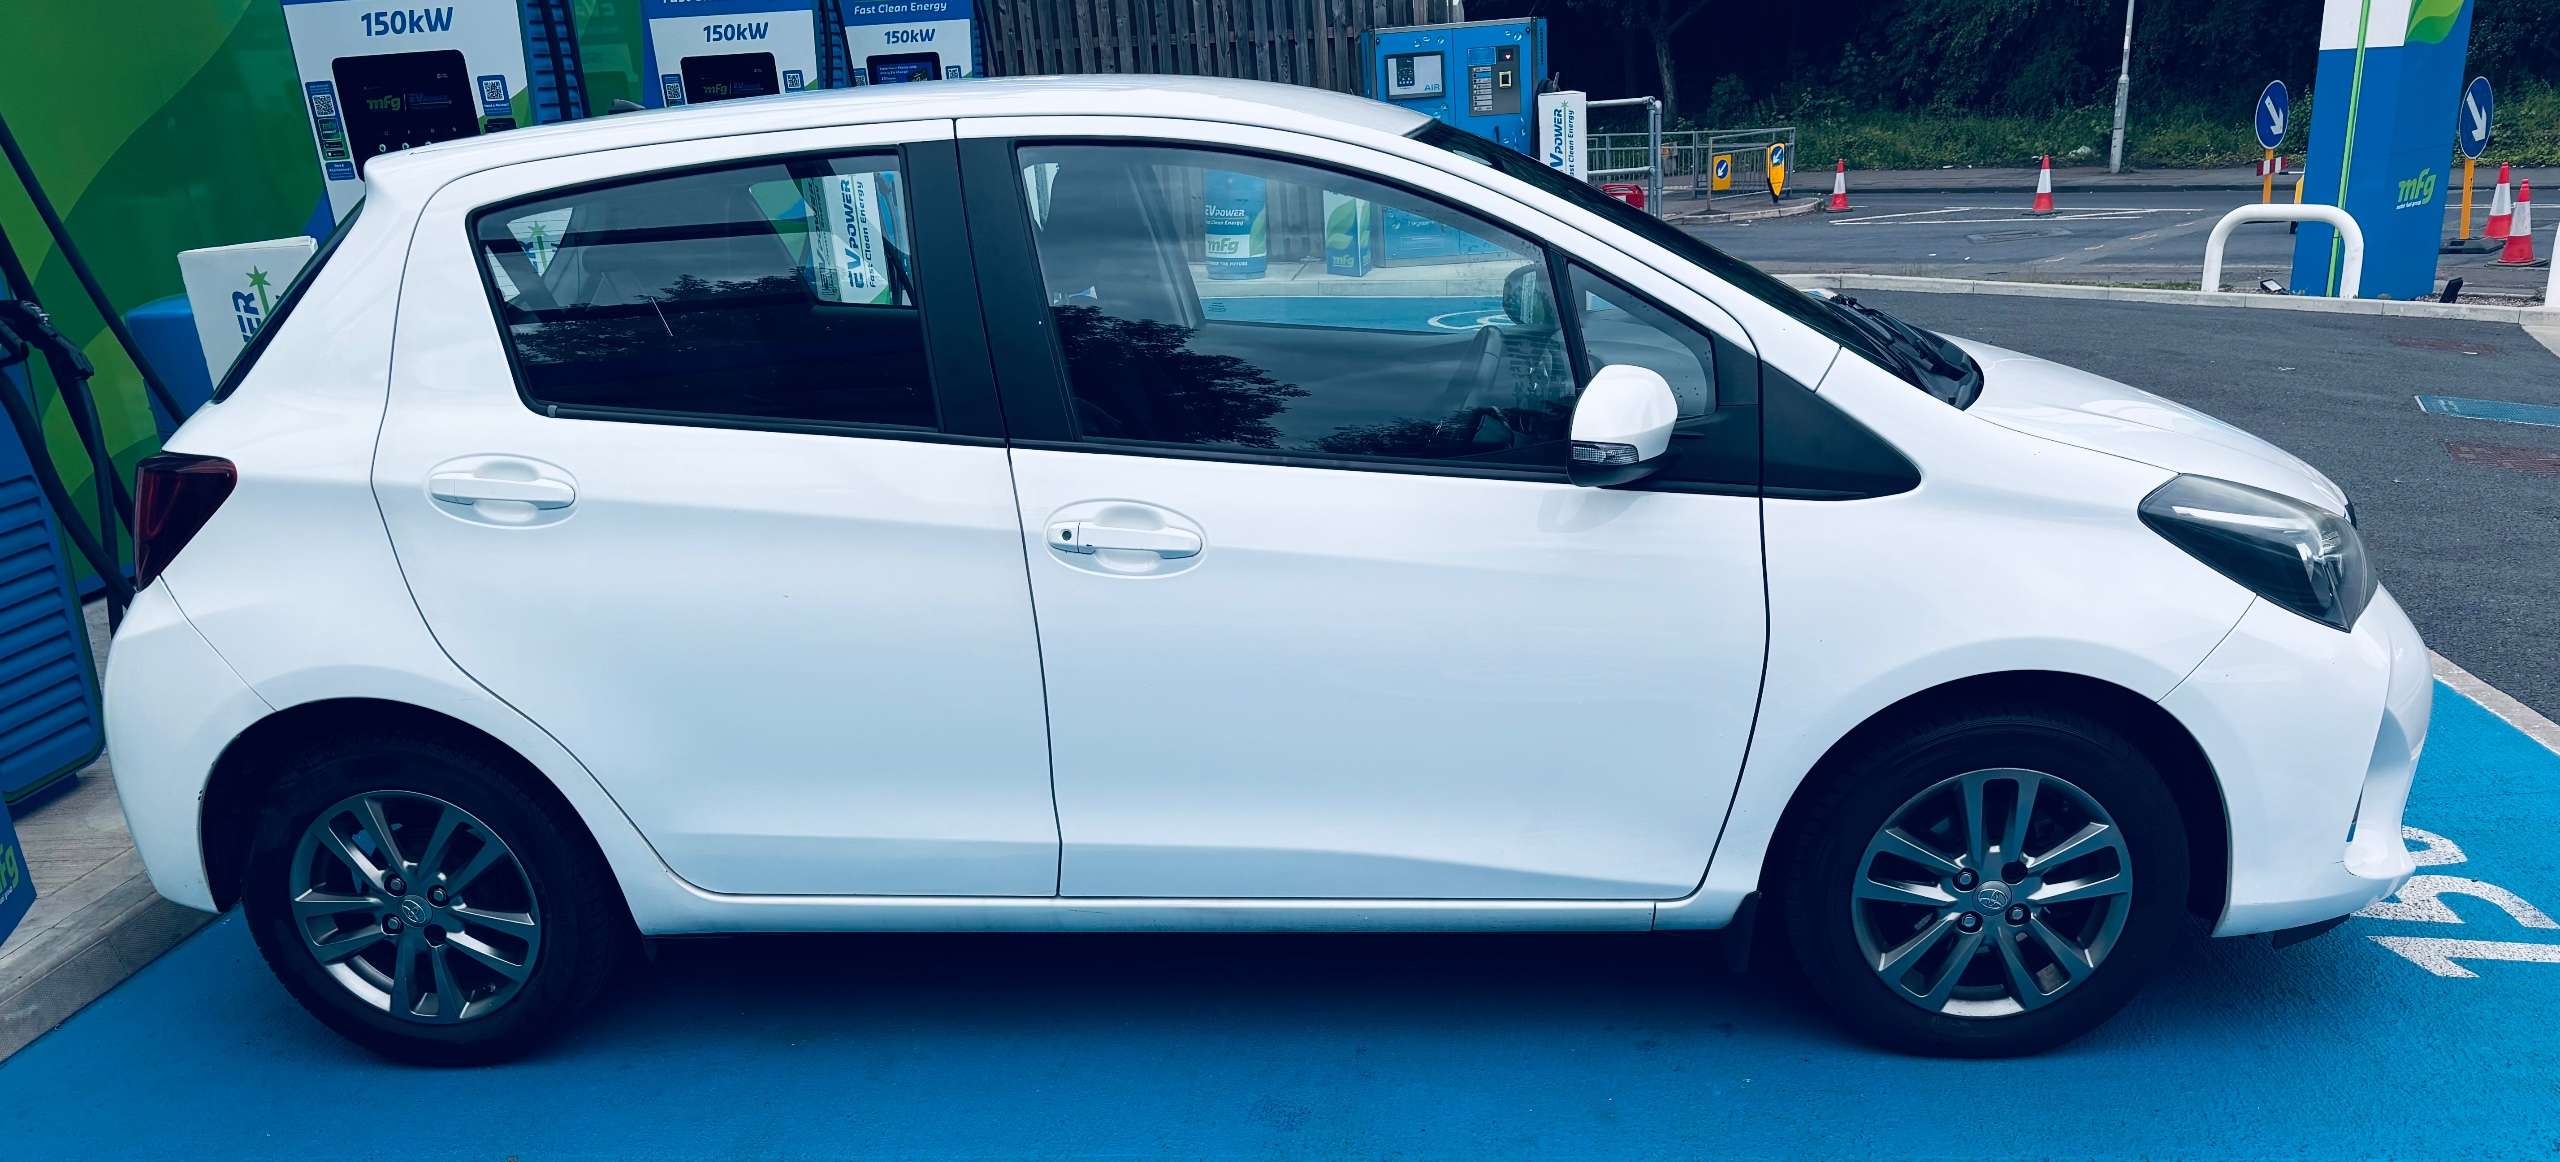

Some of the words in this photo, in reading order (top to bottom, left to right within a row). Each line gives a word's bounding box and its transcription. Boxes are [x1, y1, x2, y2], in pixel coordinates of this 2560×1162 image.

[854, 5, 876, 15] Fast
[878, 4, 908, 13] Clean
[910, 1, 947, 12] Energy
[361, 6, 454, 37] 150kW
[703, 22, 769, 43] 150kW
[884, 28, 936, 44] 150kW
[703, 83, 728, 95] mfg
[1424, 83, 1440, 92] AIR
[366, 94, 401, 111] mfg
[1568, 110, 1576, 138] Energy
[1550, 108, 1564, 168] VPOWER
[2397, 167, 2437, 205] mfg
[857, 181, 867, 224] Energy
[863, 228, 872, 260] Clean
[1207, 237, 1240, 255] mfg
[1332, 254, 1354, 267] mfg
